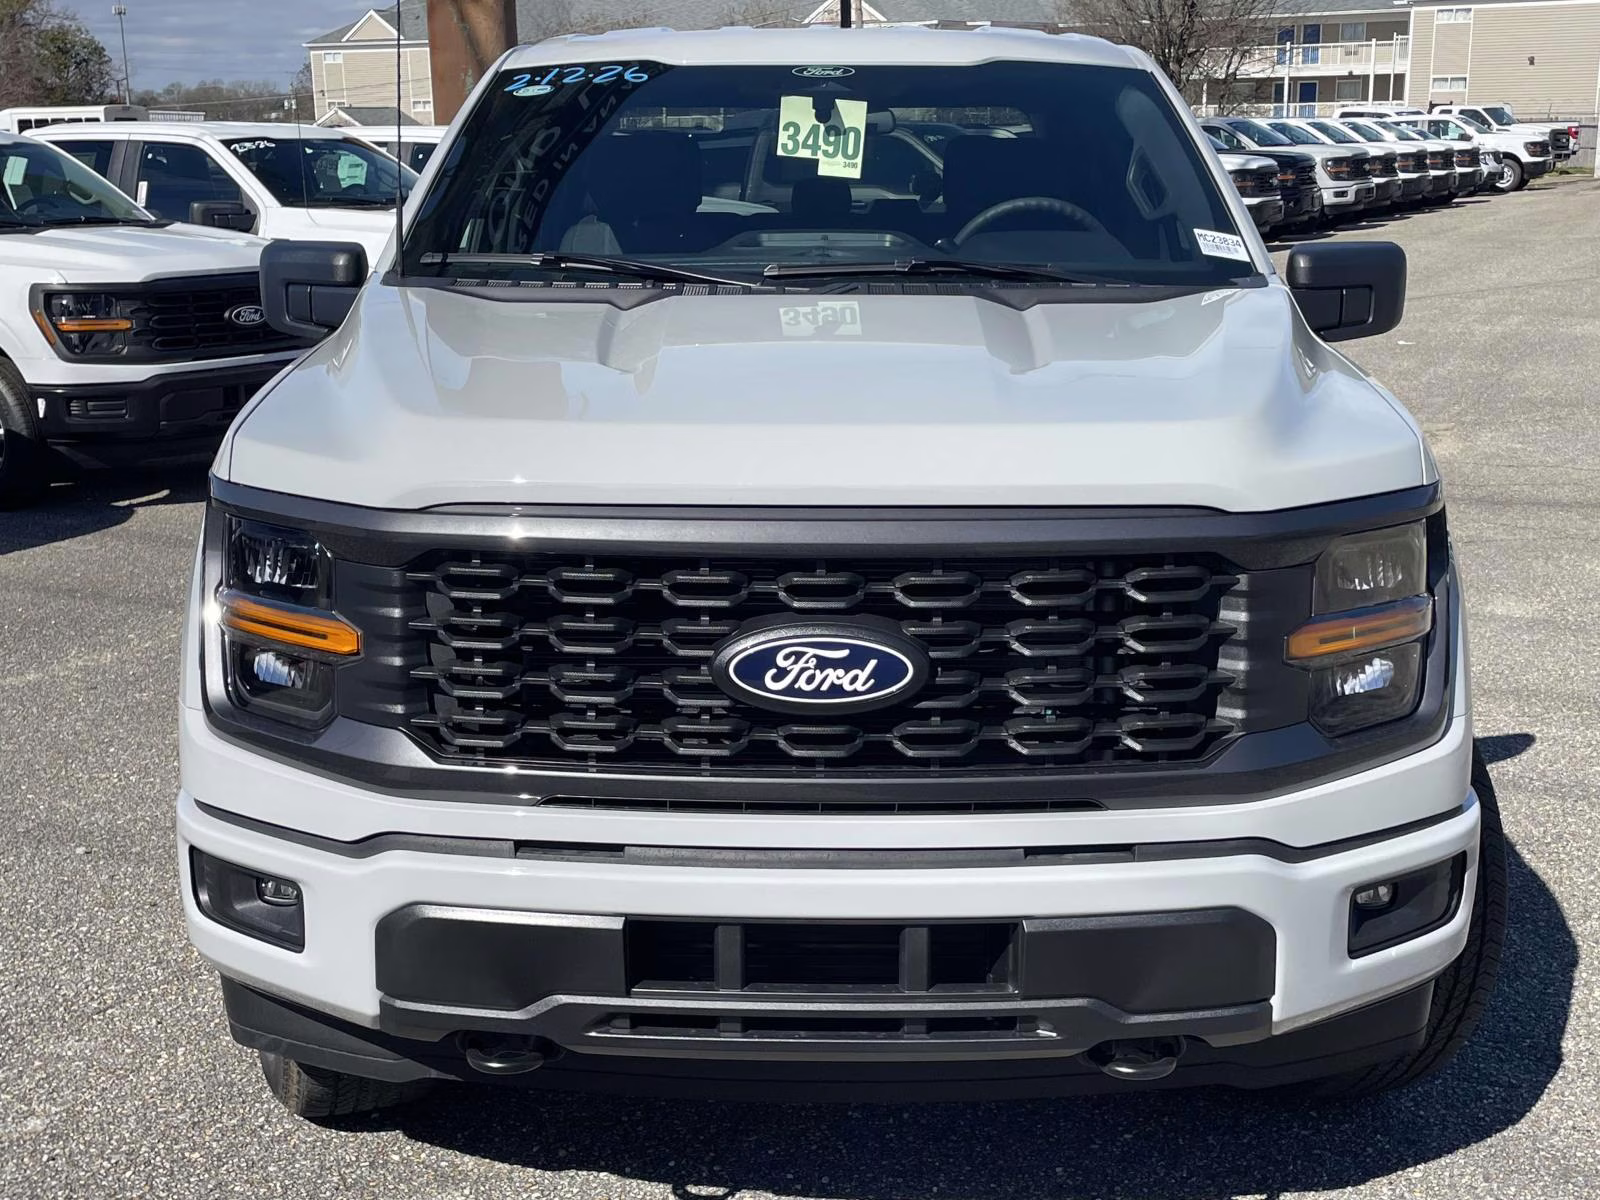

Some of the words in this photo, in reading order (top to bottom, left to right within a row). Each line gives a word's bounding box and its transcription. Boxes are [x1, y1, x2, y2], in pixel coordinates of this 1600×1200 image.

[802, 66, 845, 76] Ford
[780, 121, 862, 160] 3490
[240, 309, 261, 322] Ford
[764, 646, 878, 692] Ford
